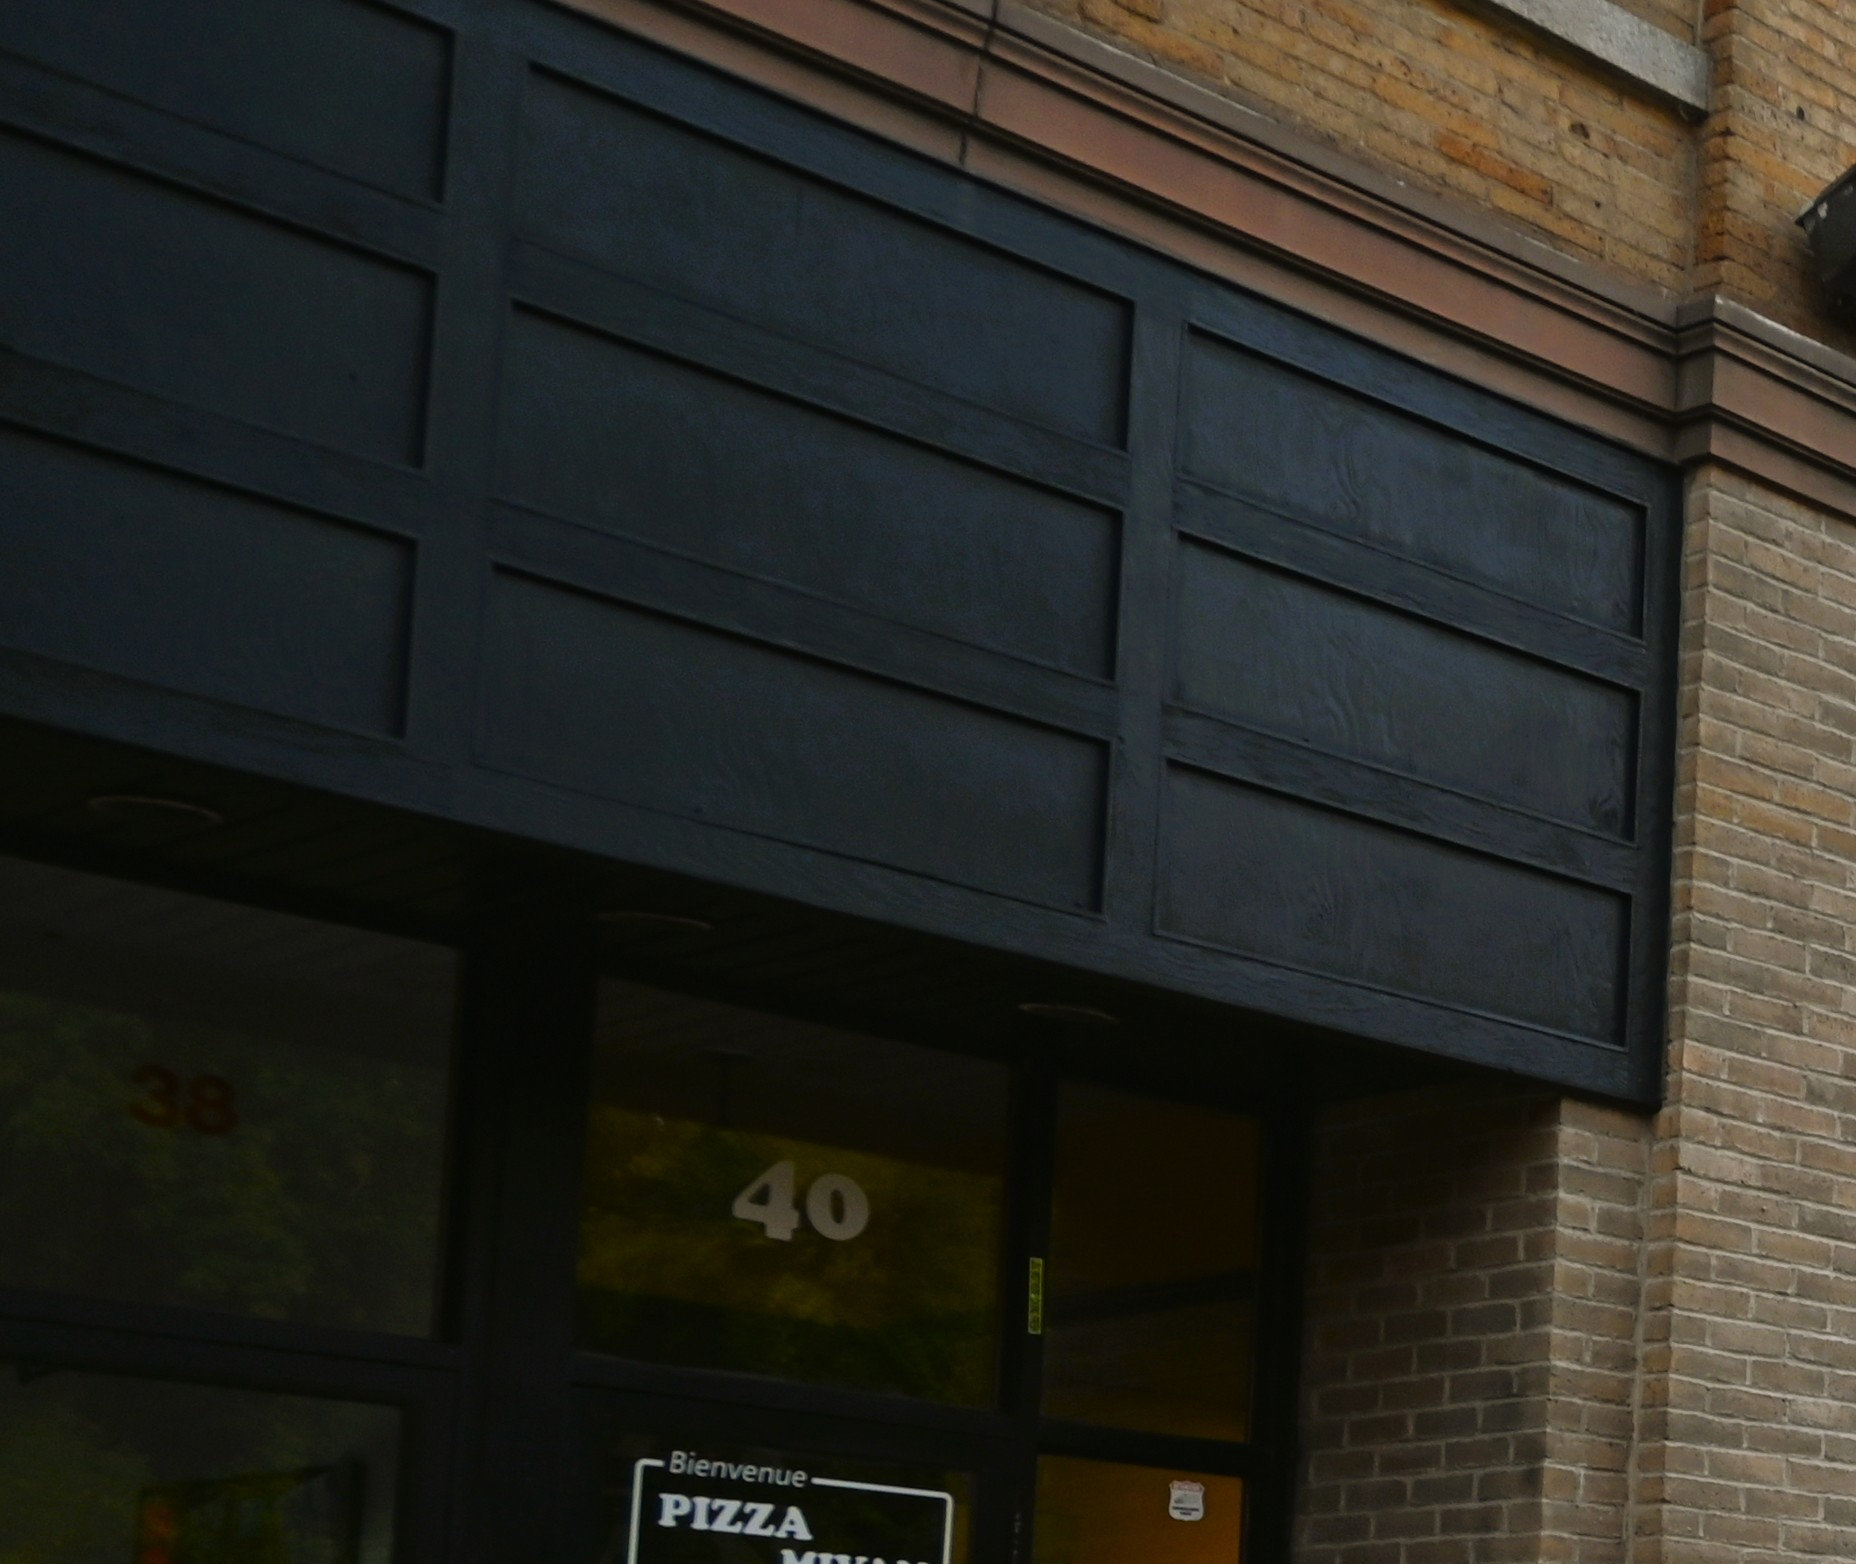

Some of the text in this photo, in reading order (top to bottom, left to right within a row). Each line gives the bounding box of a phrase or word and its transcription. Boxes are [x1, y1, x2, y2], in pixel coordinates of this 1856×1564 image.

[732, 1160, 870, 1242] 40
[668, 1450, 808, 1488] Bienvenue
[658, 1492, 813, 1541] PIZZA
